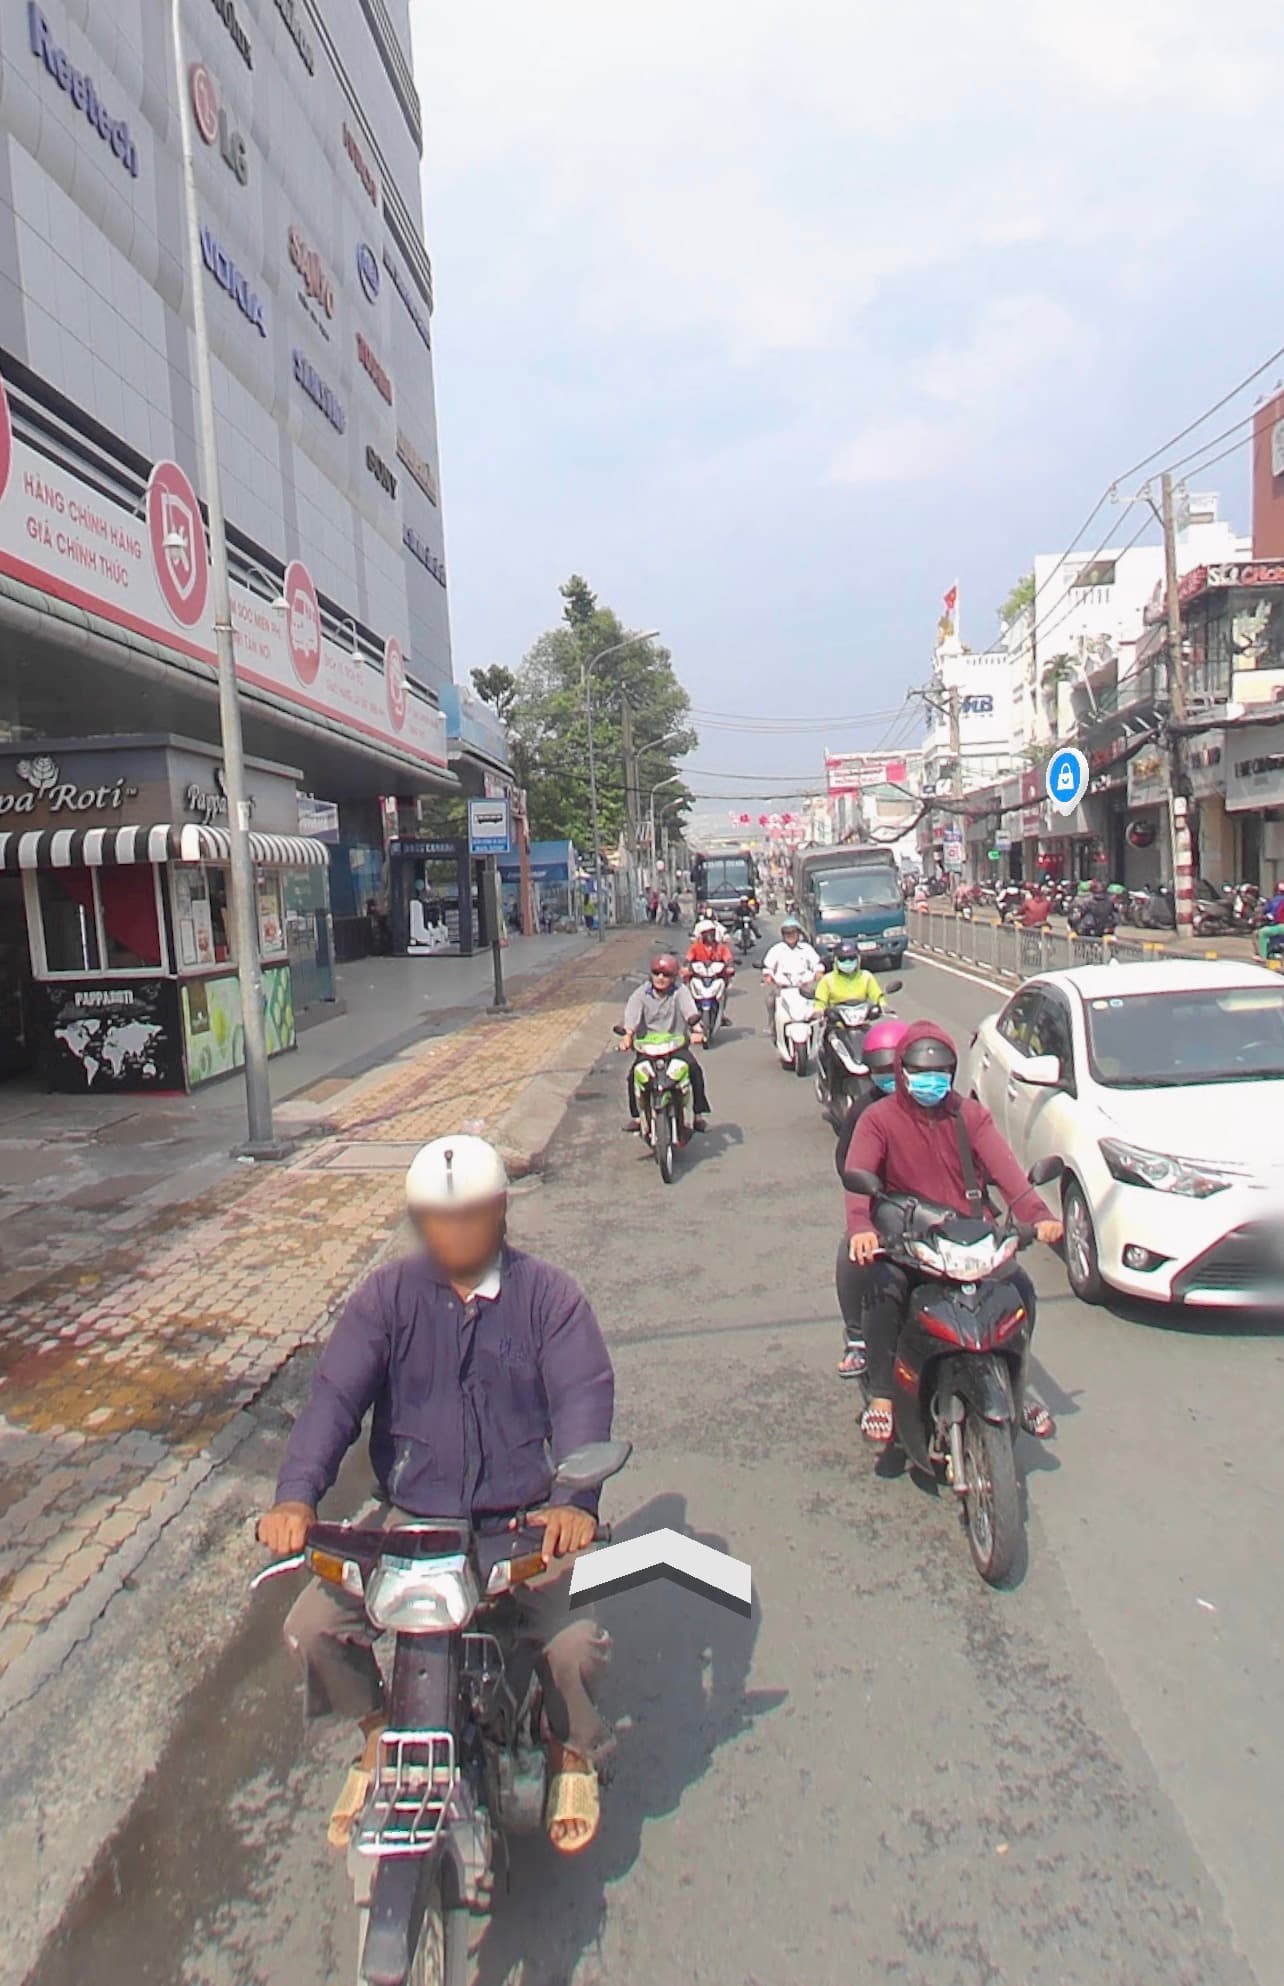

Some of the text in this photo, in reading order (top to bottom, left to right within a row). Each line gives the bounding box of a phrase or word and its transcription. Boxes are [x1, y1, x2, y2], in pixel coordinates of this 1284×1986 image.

[28, 0, 138, 178] Reetech
[218, 107, 248, 187] LG
[366, 444, 399, 501] SONY
[24, 471, 142, 560] HÀNG CHÍNH HÀNG
[26, 515, 53, 549] GIÁ
[56, 533, 98, 572] CHÍNH
